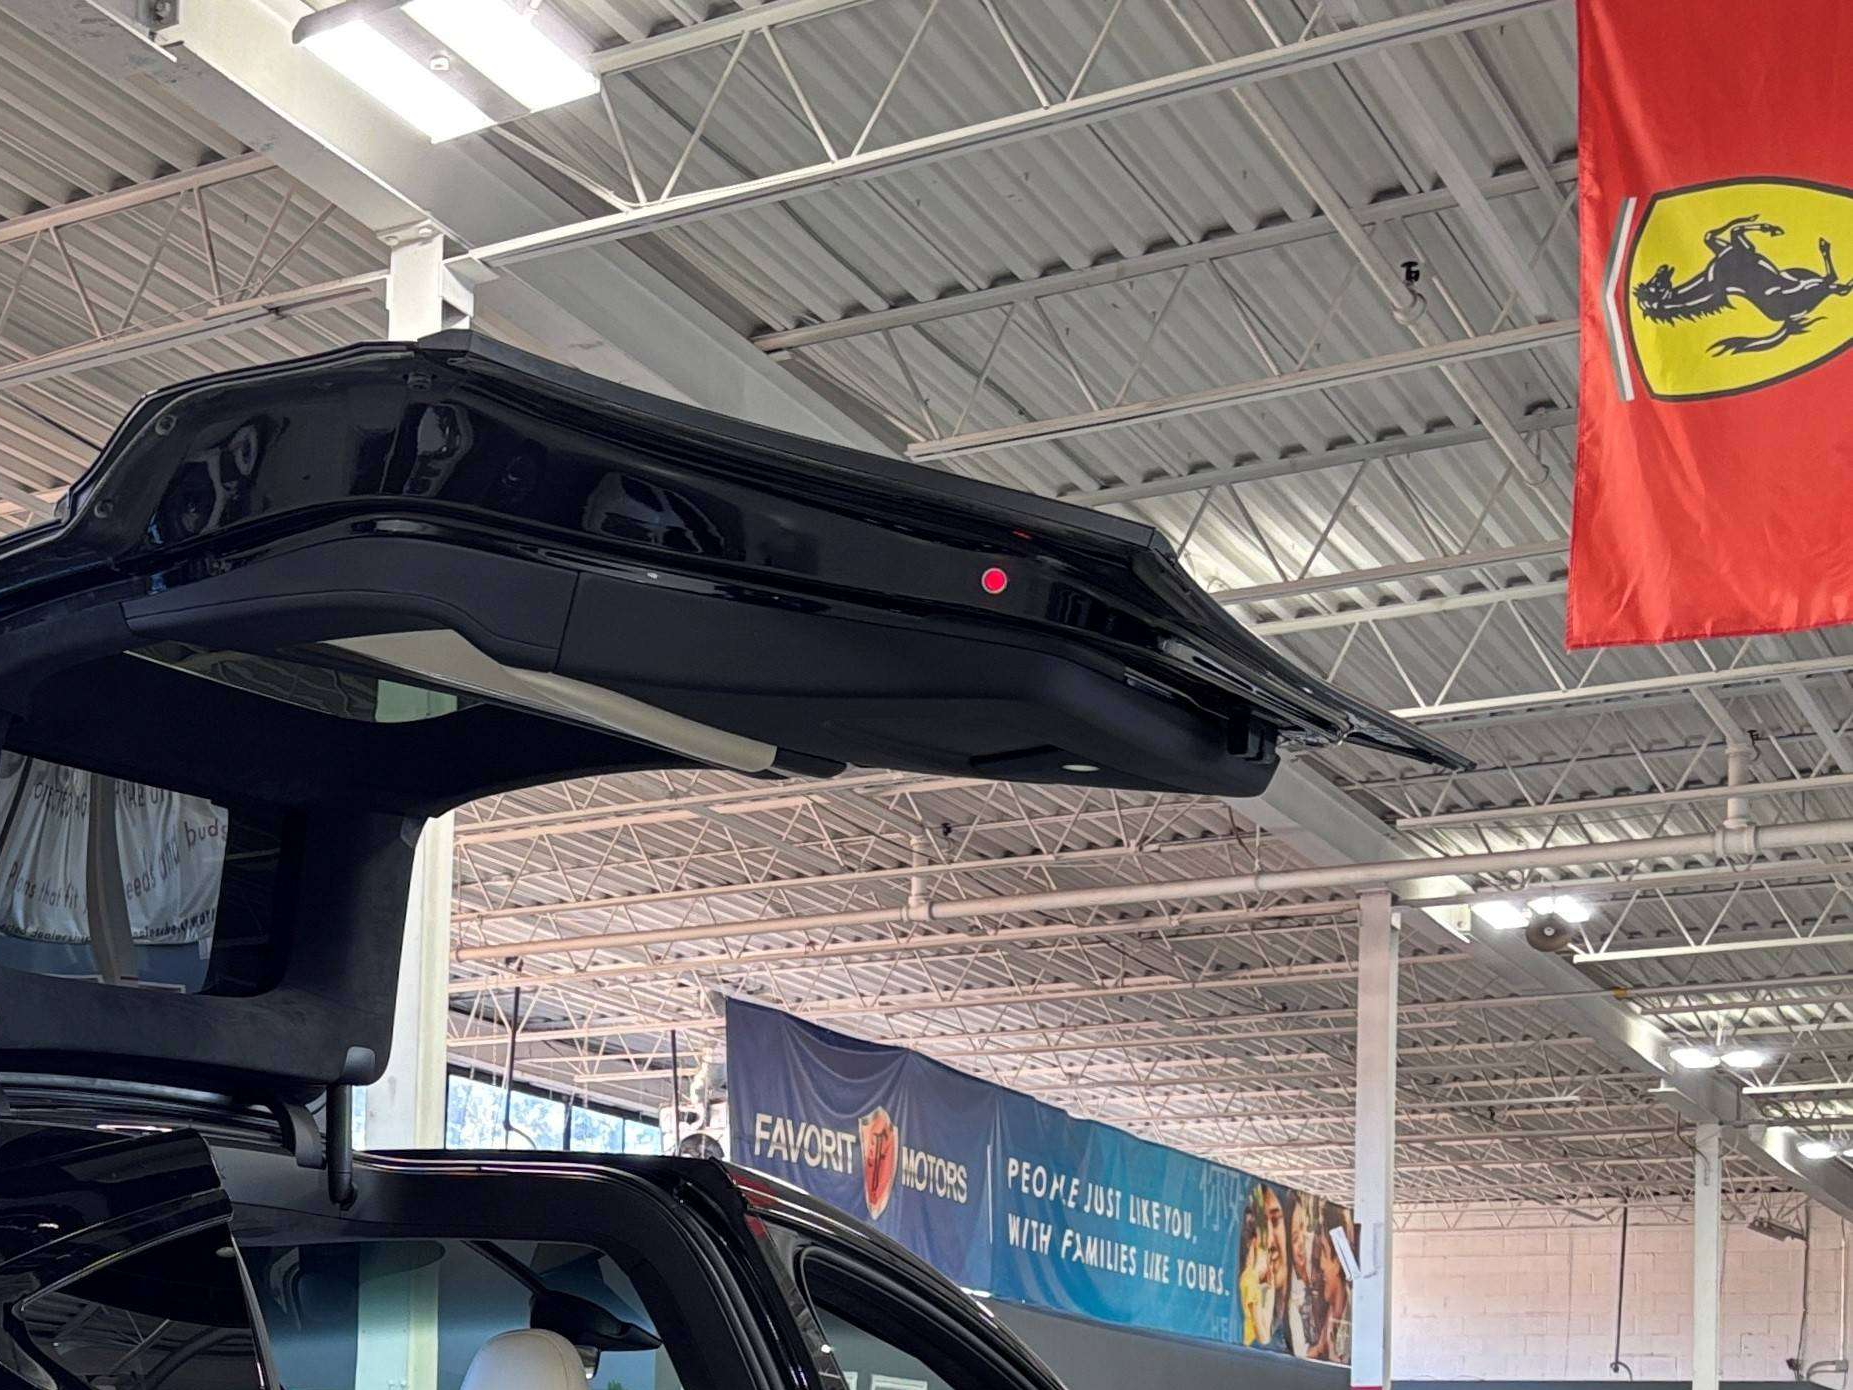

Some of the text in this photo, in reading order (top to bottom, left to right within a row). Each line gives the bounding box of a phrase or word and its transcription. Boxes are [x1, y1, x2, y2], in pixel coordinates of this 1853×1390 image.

[753, 1112, 857, 1175] FAVORIT
[901, 1146, 969, 1204] MOTORS
[1083, 1182, 1122, 1220] JUST
[1129, 1194, 1160, 1231] LIKE
[1007, 1212, 1230, 1296] WITH FAMILIES LIKE YOURS.
